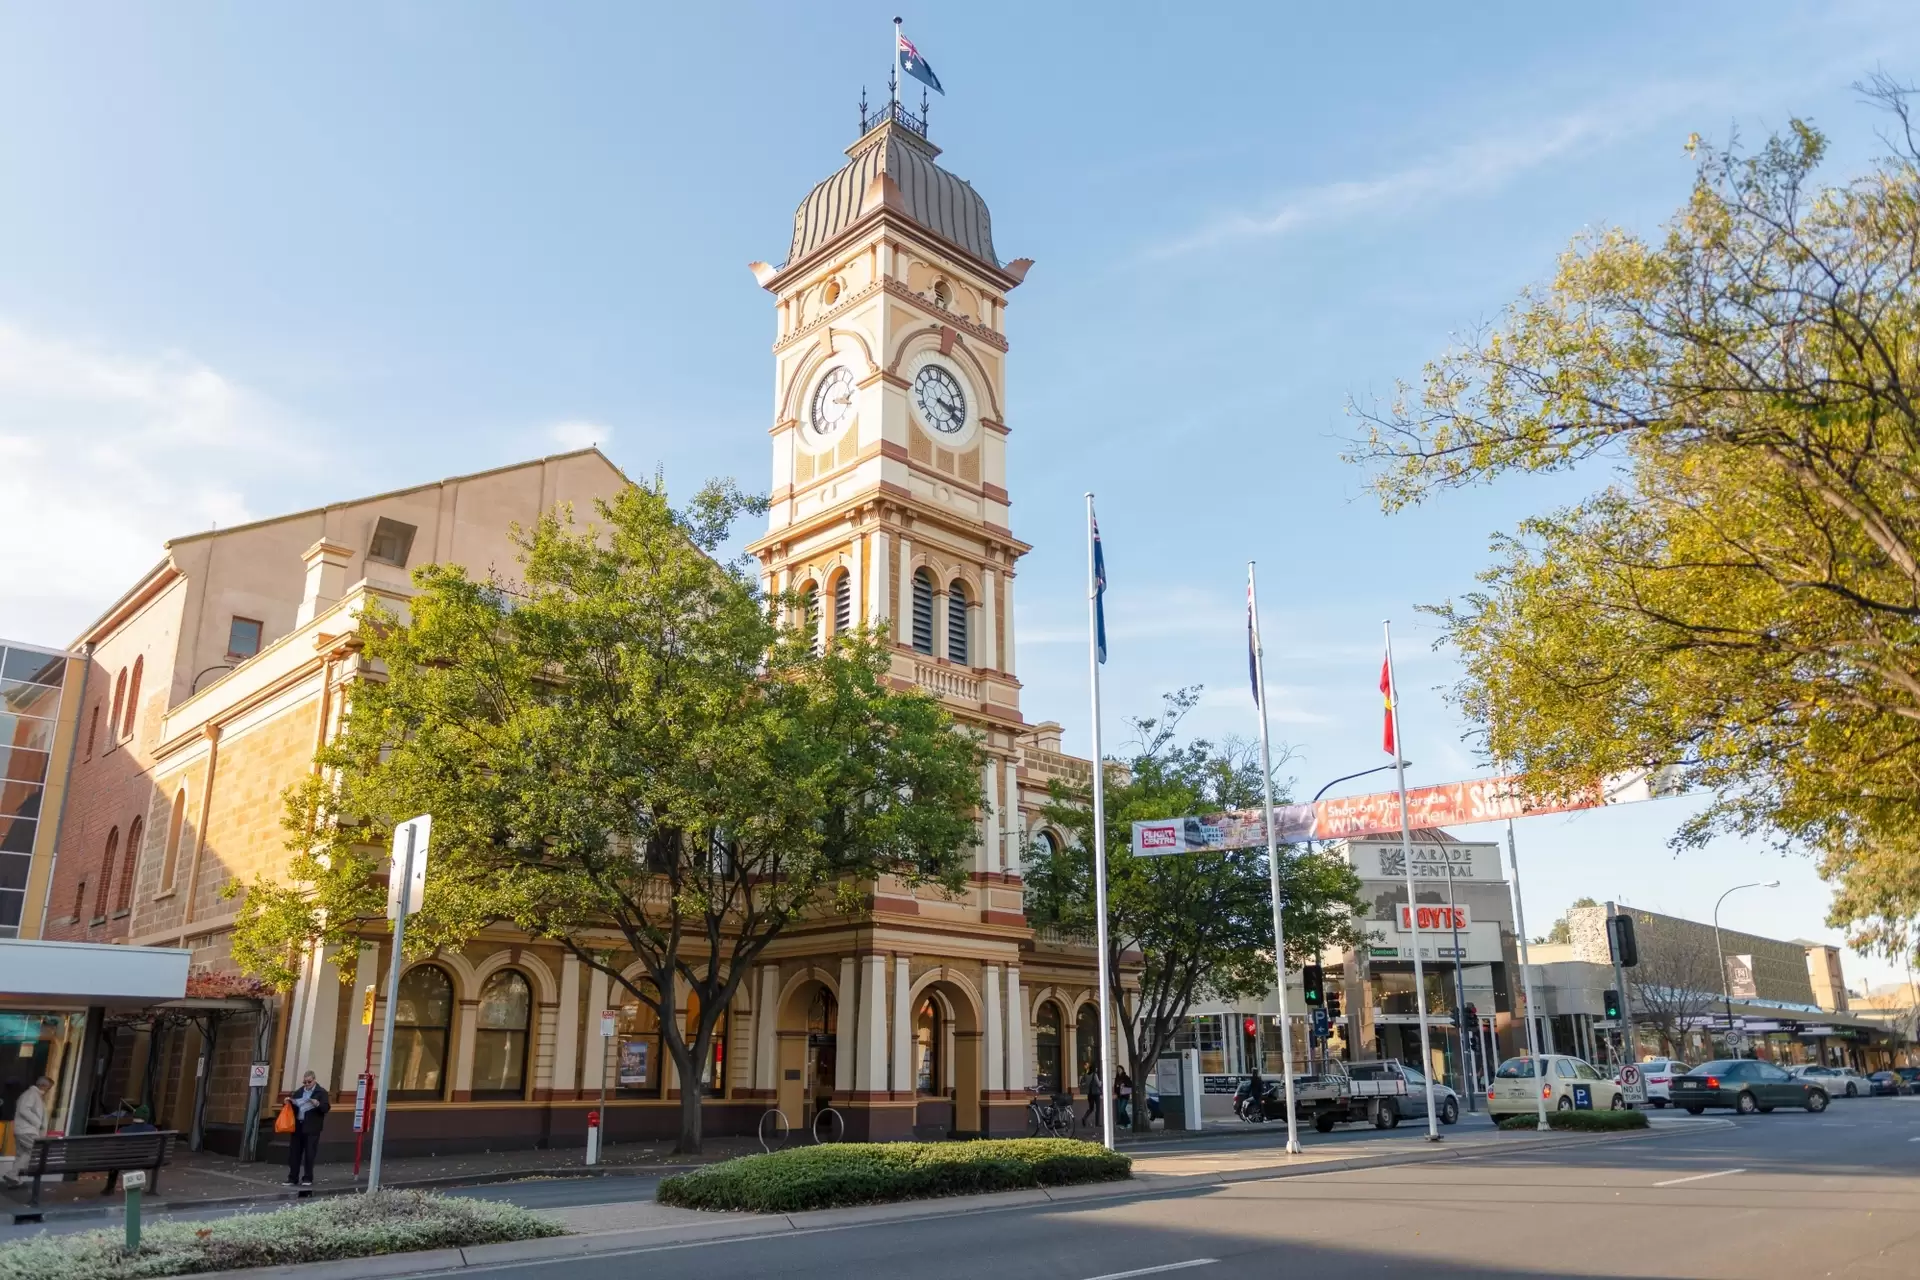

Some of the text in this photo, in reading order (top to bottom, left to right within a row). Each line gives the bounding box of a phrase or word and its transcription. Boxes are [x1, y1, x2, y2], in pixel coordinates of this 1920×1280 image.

[1327, 804, 1356, 817] Shop
[1359, 803, 1375, 813] on
[1378, 798, 1400, 811] The
[1328, 817, 1365, 833] WIN
[1369, 819, 1378, 829] a
[1451, 805, 1466, 822] in
[1143, 830, 1173, 839] FLIGHT
[1143, 837, 1175, 845] CENTRE
[1411, 865, 1474, 877] CENTRAL
[1315, 1011, 1325, 1024] P
[1728, 1035, 1737, 1043] 50
[1576, 1089, 1586, 1100] P
[1623, 1085, 1642, 1093] NO U
